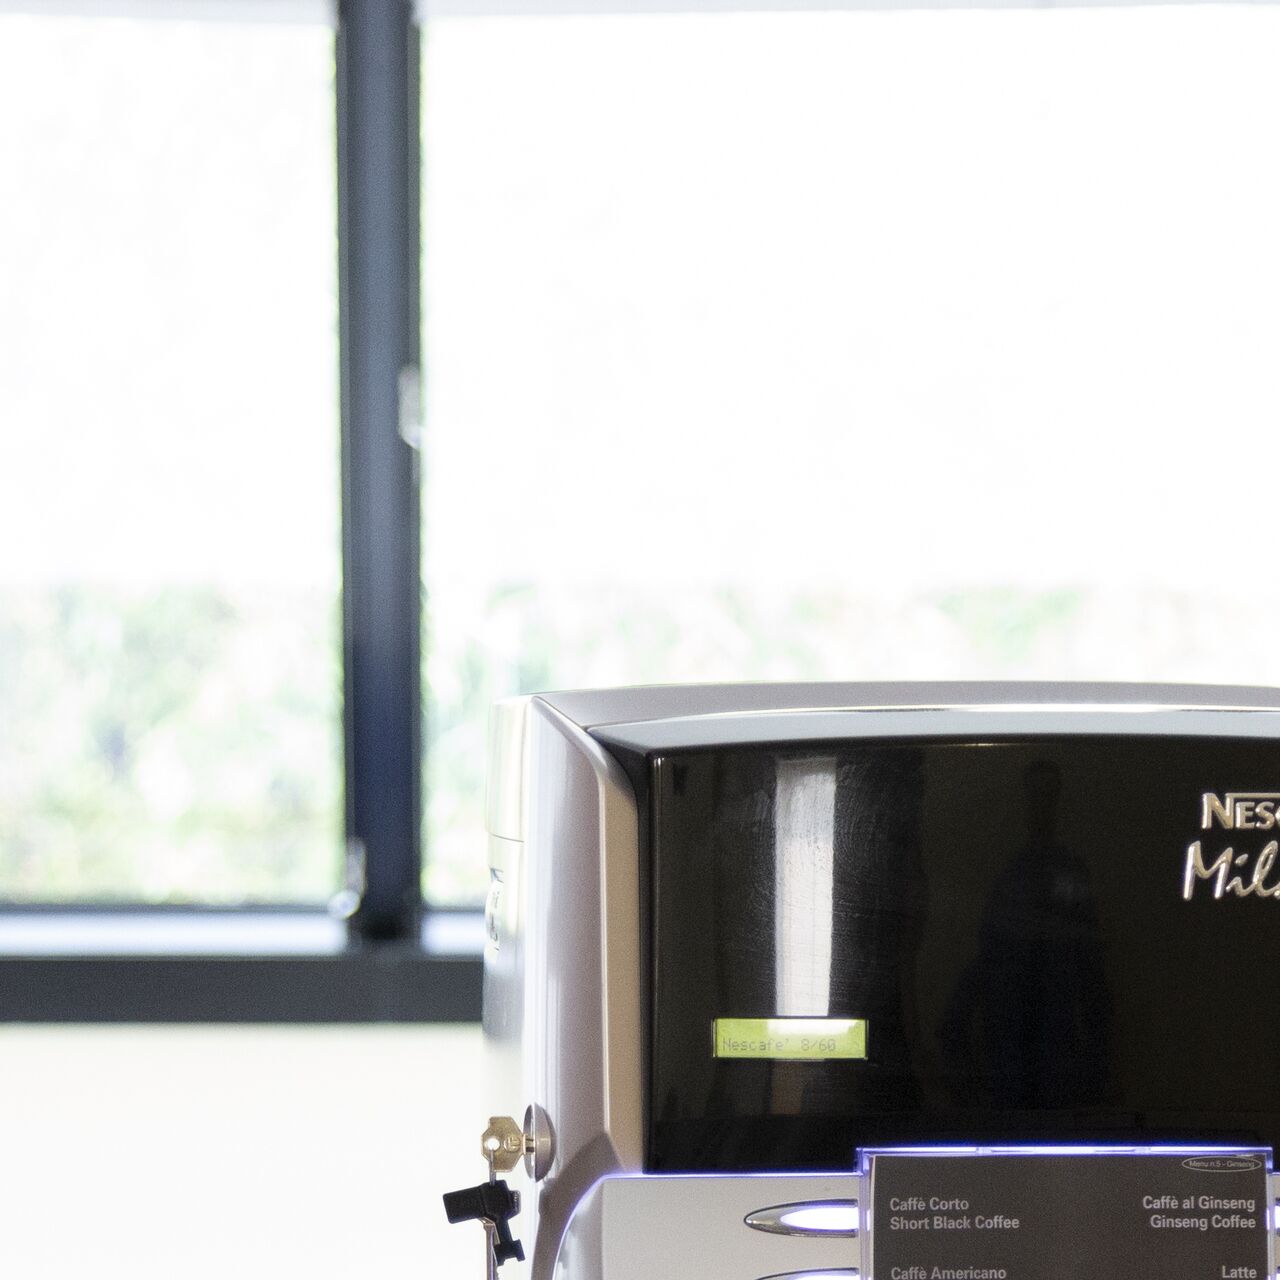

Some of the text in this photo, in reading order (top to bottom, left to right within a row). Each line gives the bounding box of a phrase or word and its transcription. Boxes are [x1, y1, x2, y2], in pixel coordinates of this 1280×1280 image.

[890, 1197, 969, 1211] Caffè Corto
[1142, 1196, 1255, 1212] Caffè al Ginseng
[890, 1216, 1020, 1230] Short Black Coffee
[1150, 1215, 1256, 1231] Ginseng Coffee
[891, 1266, 1006, 1280] Caffè Americano
[1222, 1266, 1257, 1279] Latte
